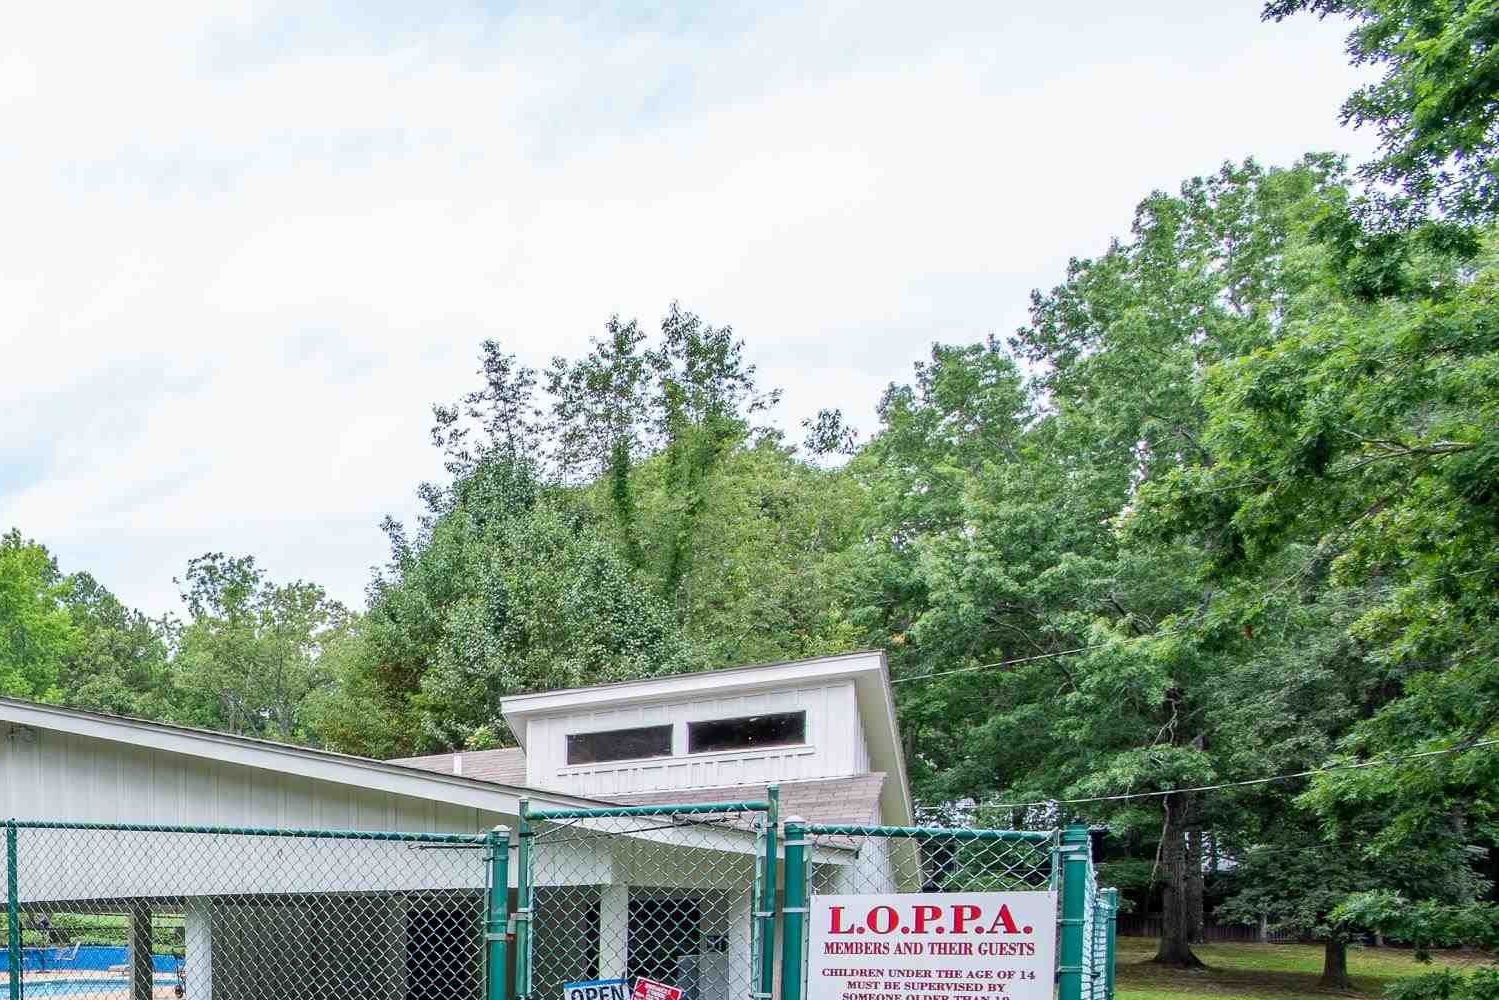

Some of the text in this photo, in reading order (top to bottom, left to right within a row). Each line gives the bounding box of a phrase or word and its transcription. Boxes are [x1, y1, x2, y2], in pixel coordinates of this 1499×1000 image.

[828, 904, 1033, 934] L.O.P.P.A.
[824, 942, 1035, 956] MEMBERS AND THEIR GUESTS
[822, 969, 1036, 980] CHILDREN UNDER THE AGE OF 14
[846, 981, 1006, 992] MUST BE SUPERVISED BY
